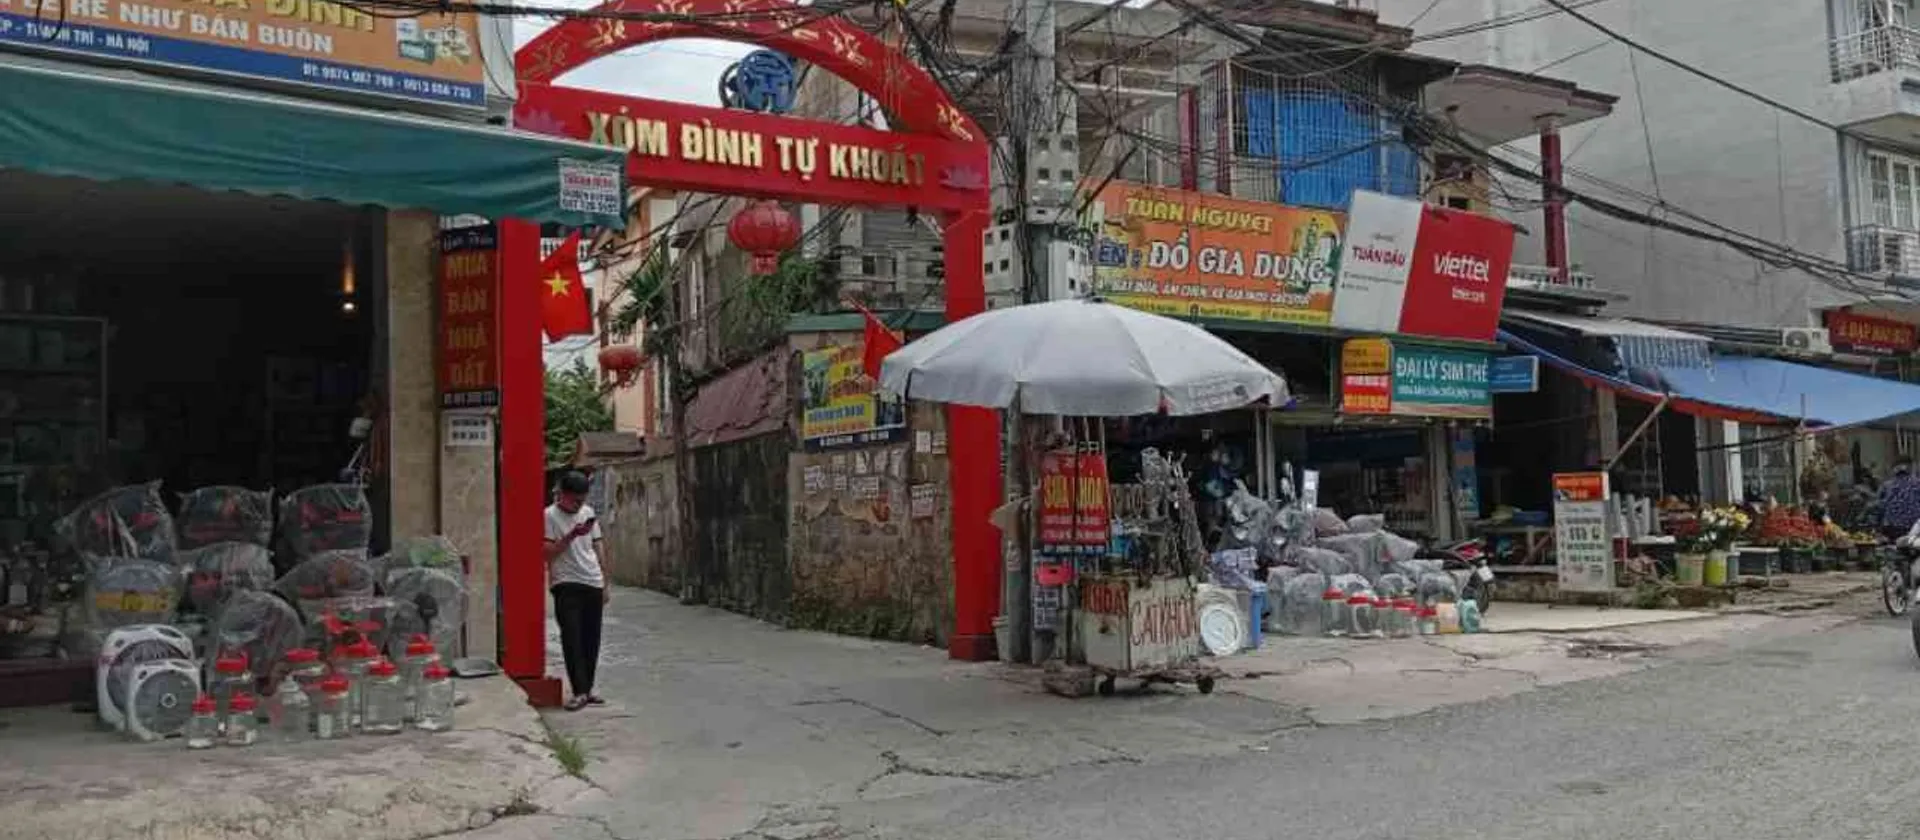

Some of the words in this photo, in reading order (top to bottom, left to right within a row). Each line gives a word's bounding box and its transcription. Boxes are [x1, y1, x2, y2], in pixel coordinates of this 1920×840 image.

[120, 2, 184, 30] NHƯ
[189, 11, 249, 41] BÁN
[257, 23, 333, 54] BUÔN
[587, 106, 669, 157] XÓM
[680, 117, 763, 168] ĐÌNH
[775, 135, 819, 181] TỰ
[829, 143, 925, 186] KHOÁT
[1149, 227, 1191, 271] ĐỒ
[1198, 246, 1245, 277] GIA
[1434, 250, 1489, 282] viettel
[1396, 356, 1421, 384] ĐẠI
[1423, 355, 1438, 379] LÝ
[1440, 361, 1464, 381] SIM
